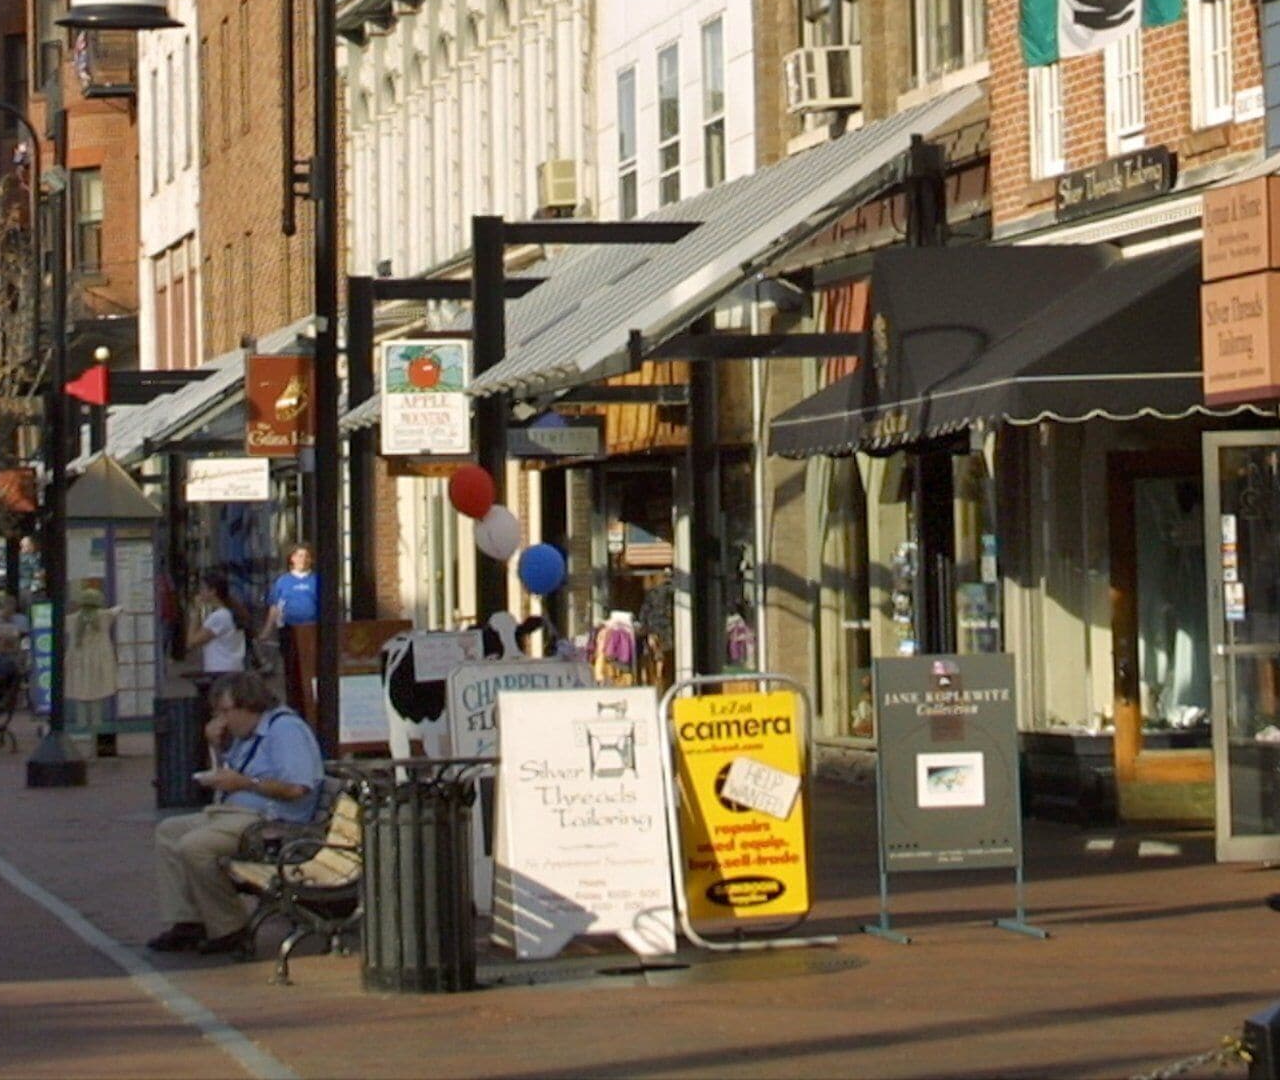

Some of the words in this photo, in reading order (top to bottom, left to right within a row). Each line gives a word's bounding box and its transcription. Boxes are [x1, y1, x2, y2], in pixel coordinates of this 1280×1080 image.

[710, 701, 752, 716] LeZot
[680, 716, 791, 741] camera
[520, 759, 584, 782] Silver
[534, 783, 637, 805] Threads
[553, 807, 653, 832] Tailoring
[715, 819, 770, 836] repairs
